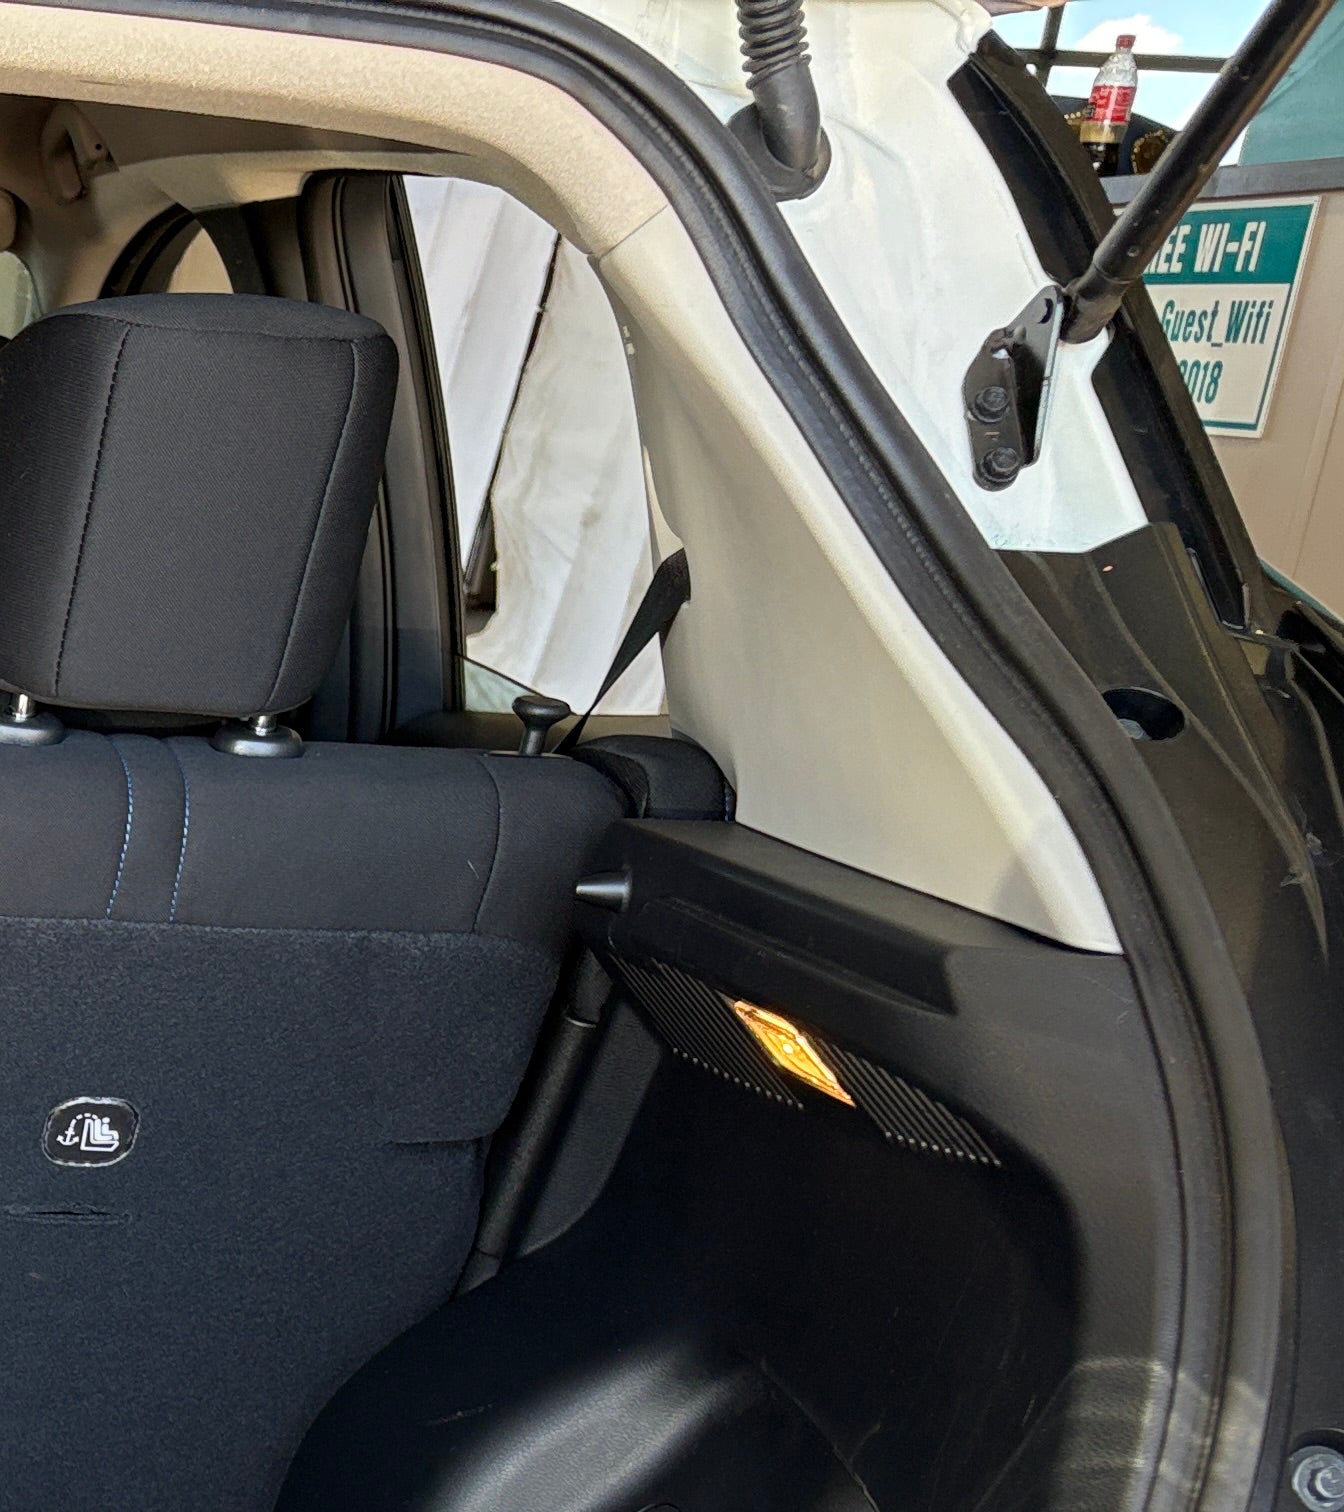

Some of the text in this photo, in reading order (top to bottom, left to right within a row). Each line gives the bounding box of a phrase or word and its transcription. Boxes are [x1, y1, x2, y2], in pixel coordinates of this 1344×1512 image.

[1143, 221, 1266, 274] EE WI-FI
[1161, 299, 1274, 348] Guest_Wifi
